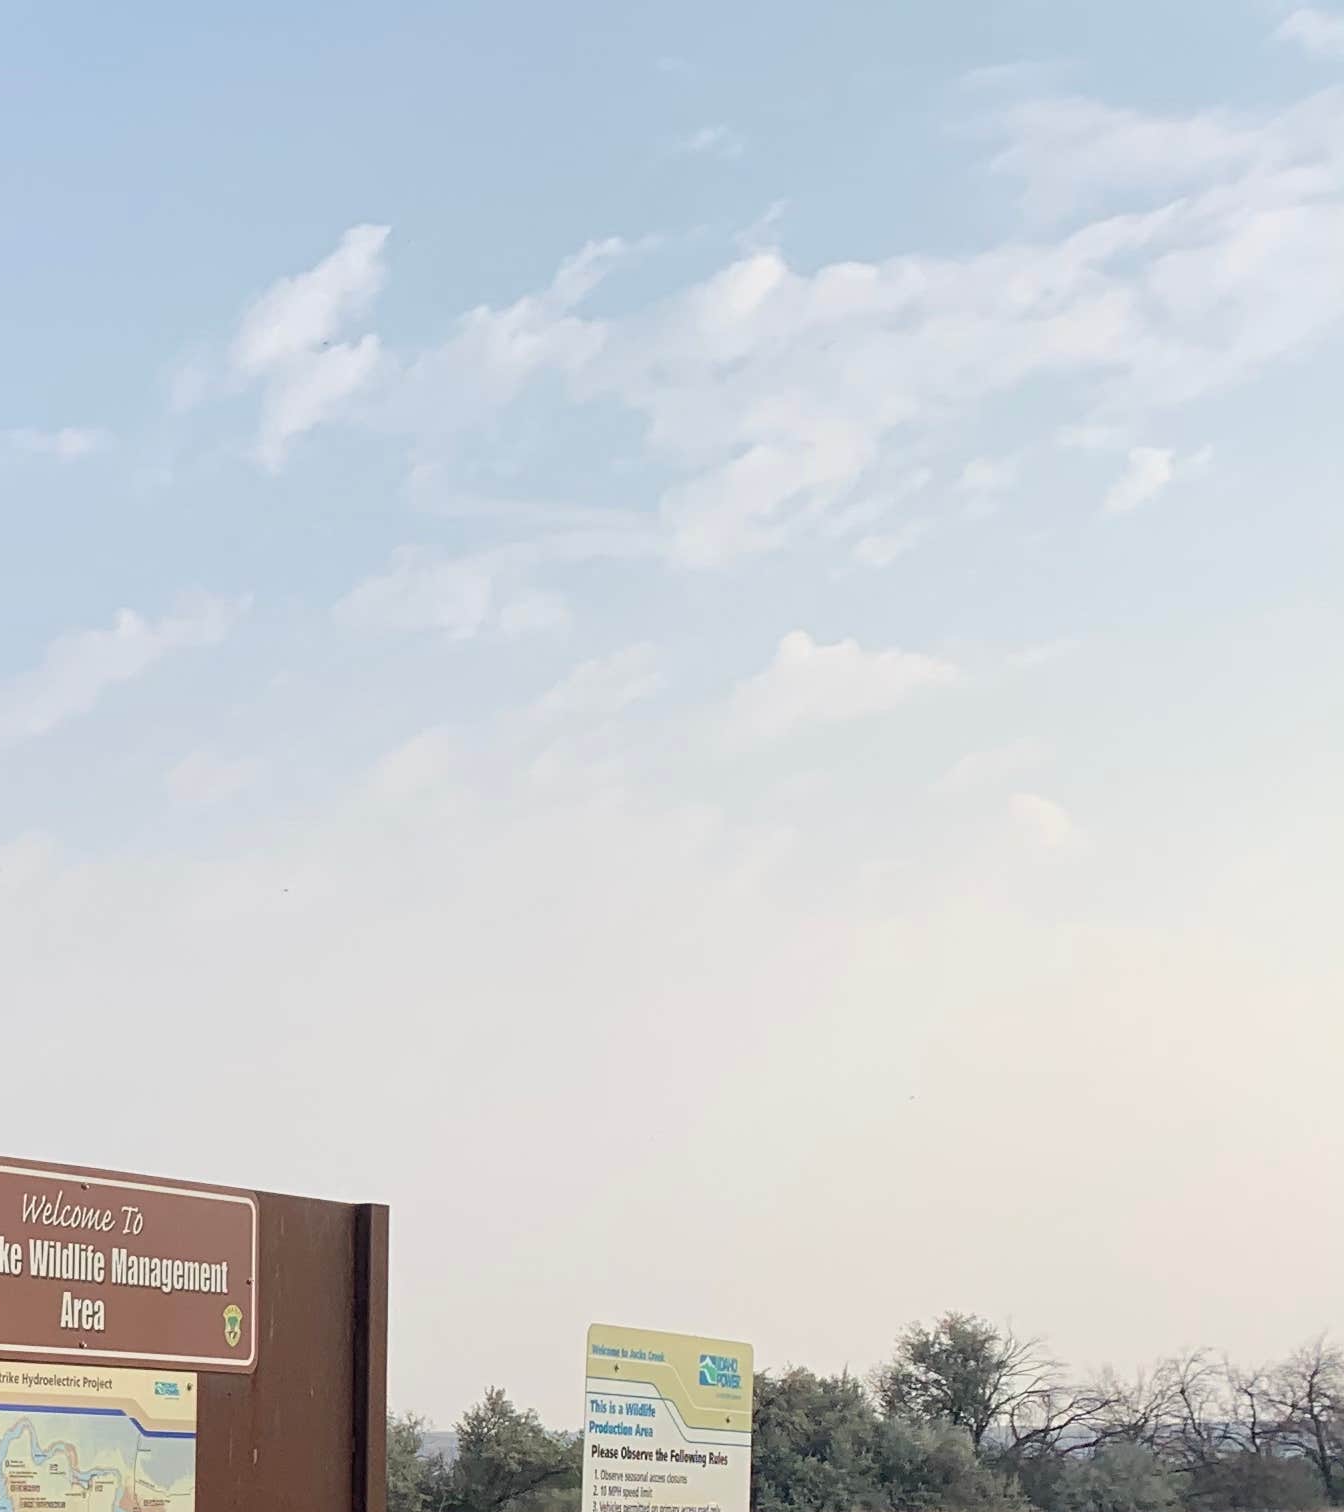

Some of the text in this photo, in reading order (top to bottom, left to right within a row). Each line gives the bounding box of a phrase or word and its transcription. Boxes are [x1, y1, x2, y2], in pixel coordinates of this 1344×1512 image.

[21, 1190, 144, 1236] Welcome To
[29, 1238, 105, 1283] Wildlife
[111, 1247, 228, 1295] Management
[60, 1291, 105, 1331] Area
[716, 1356, 738, 1373] IDAHO
[22, 1373, 81, 1388] Hydroelectric
[82, 1376, 113, 1391] Project
[716, 1373, 742, 1390] POWER
[590, 1399, 607, 1413] This
[609, 1401, 616, 1414] is
[625, 1402, 656, 1418] Wildlife
[589, 1420, 653, 1437] Production Area
[591, 1444, 728, 1468] Please Observe the Following Rules
